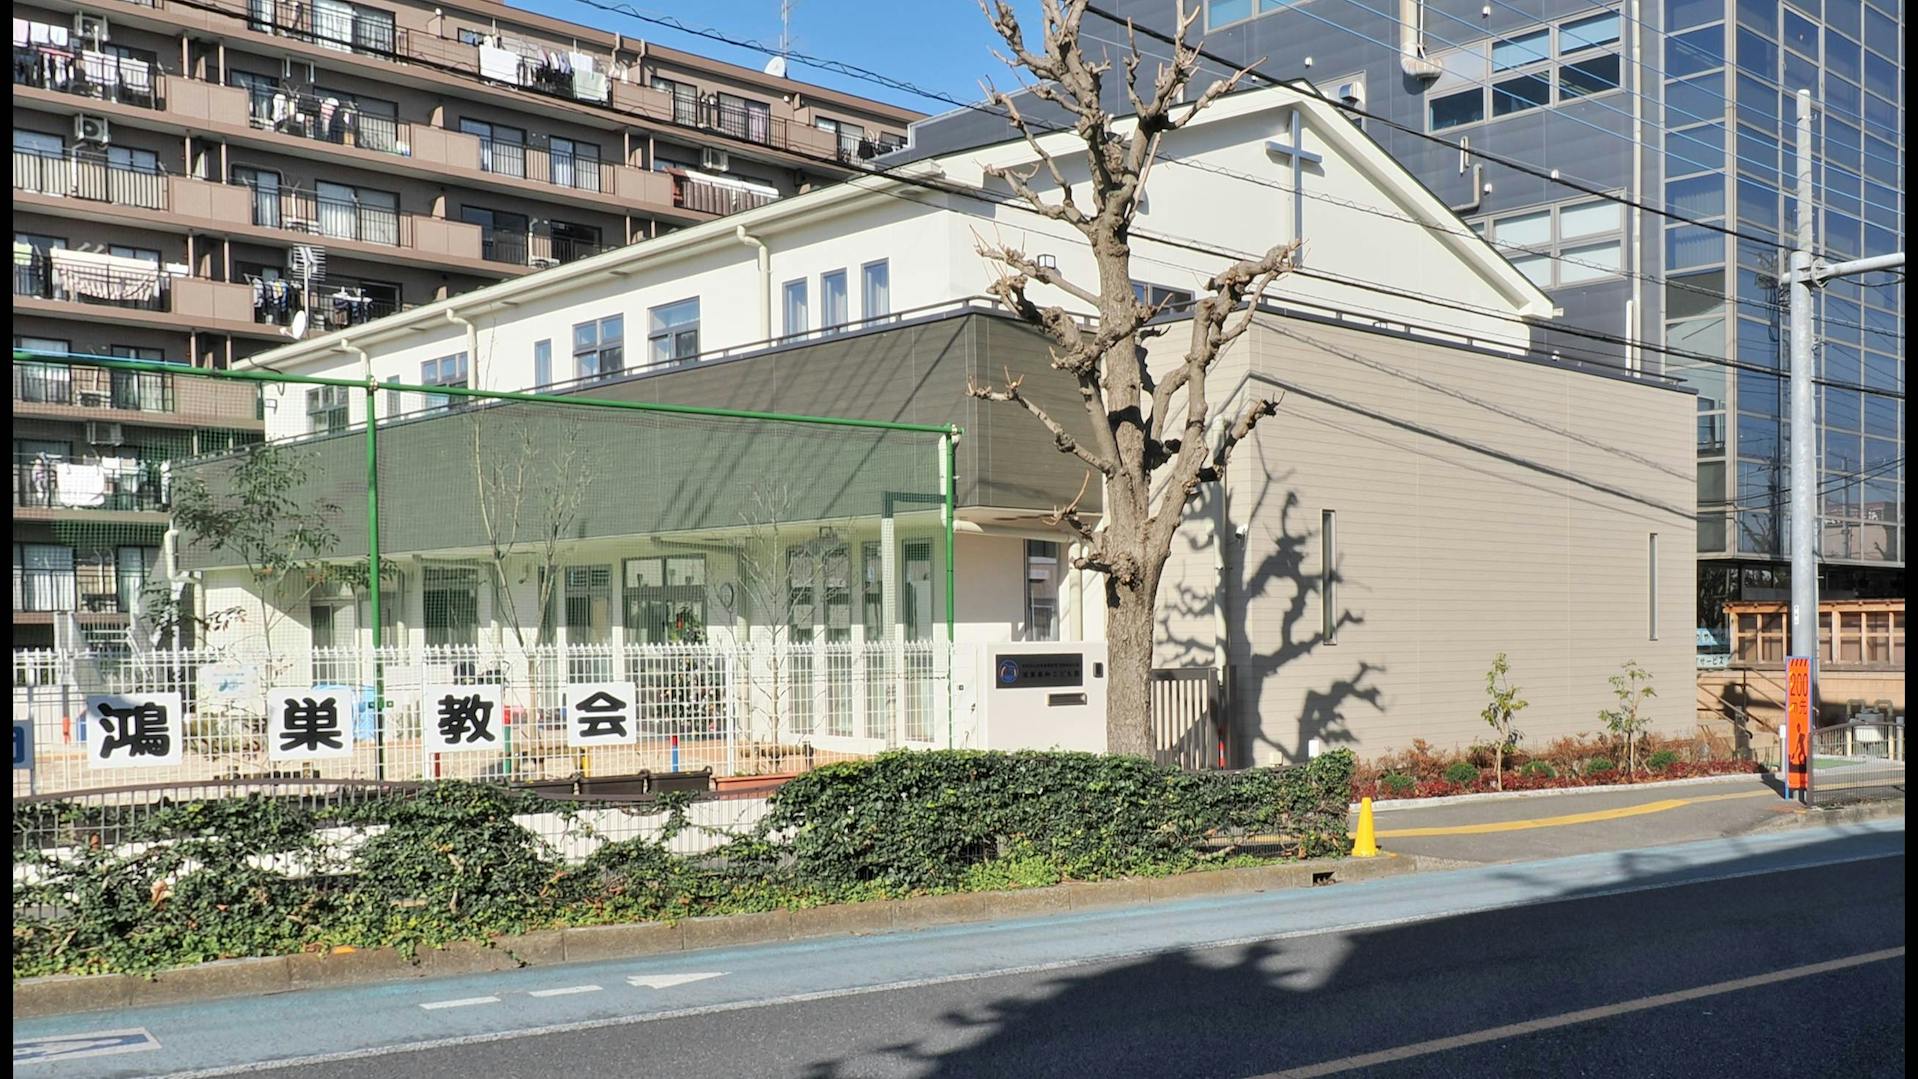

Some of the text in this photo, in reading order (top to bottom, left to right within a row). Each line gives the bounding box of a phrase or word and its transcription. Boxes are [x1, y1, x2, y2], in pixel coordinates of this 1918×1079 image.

[1790, 673, 1809, 697] 200
[97, 692, 626, 758] 鴻 巣 教 会
